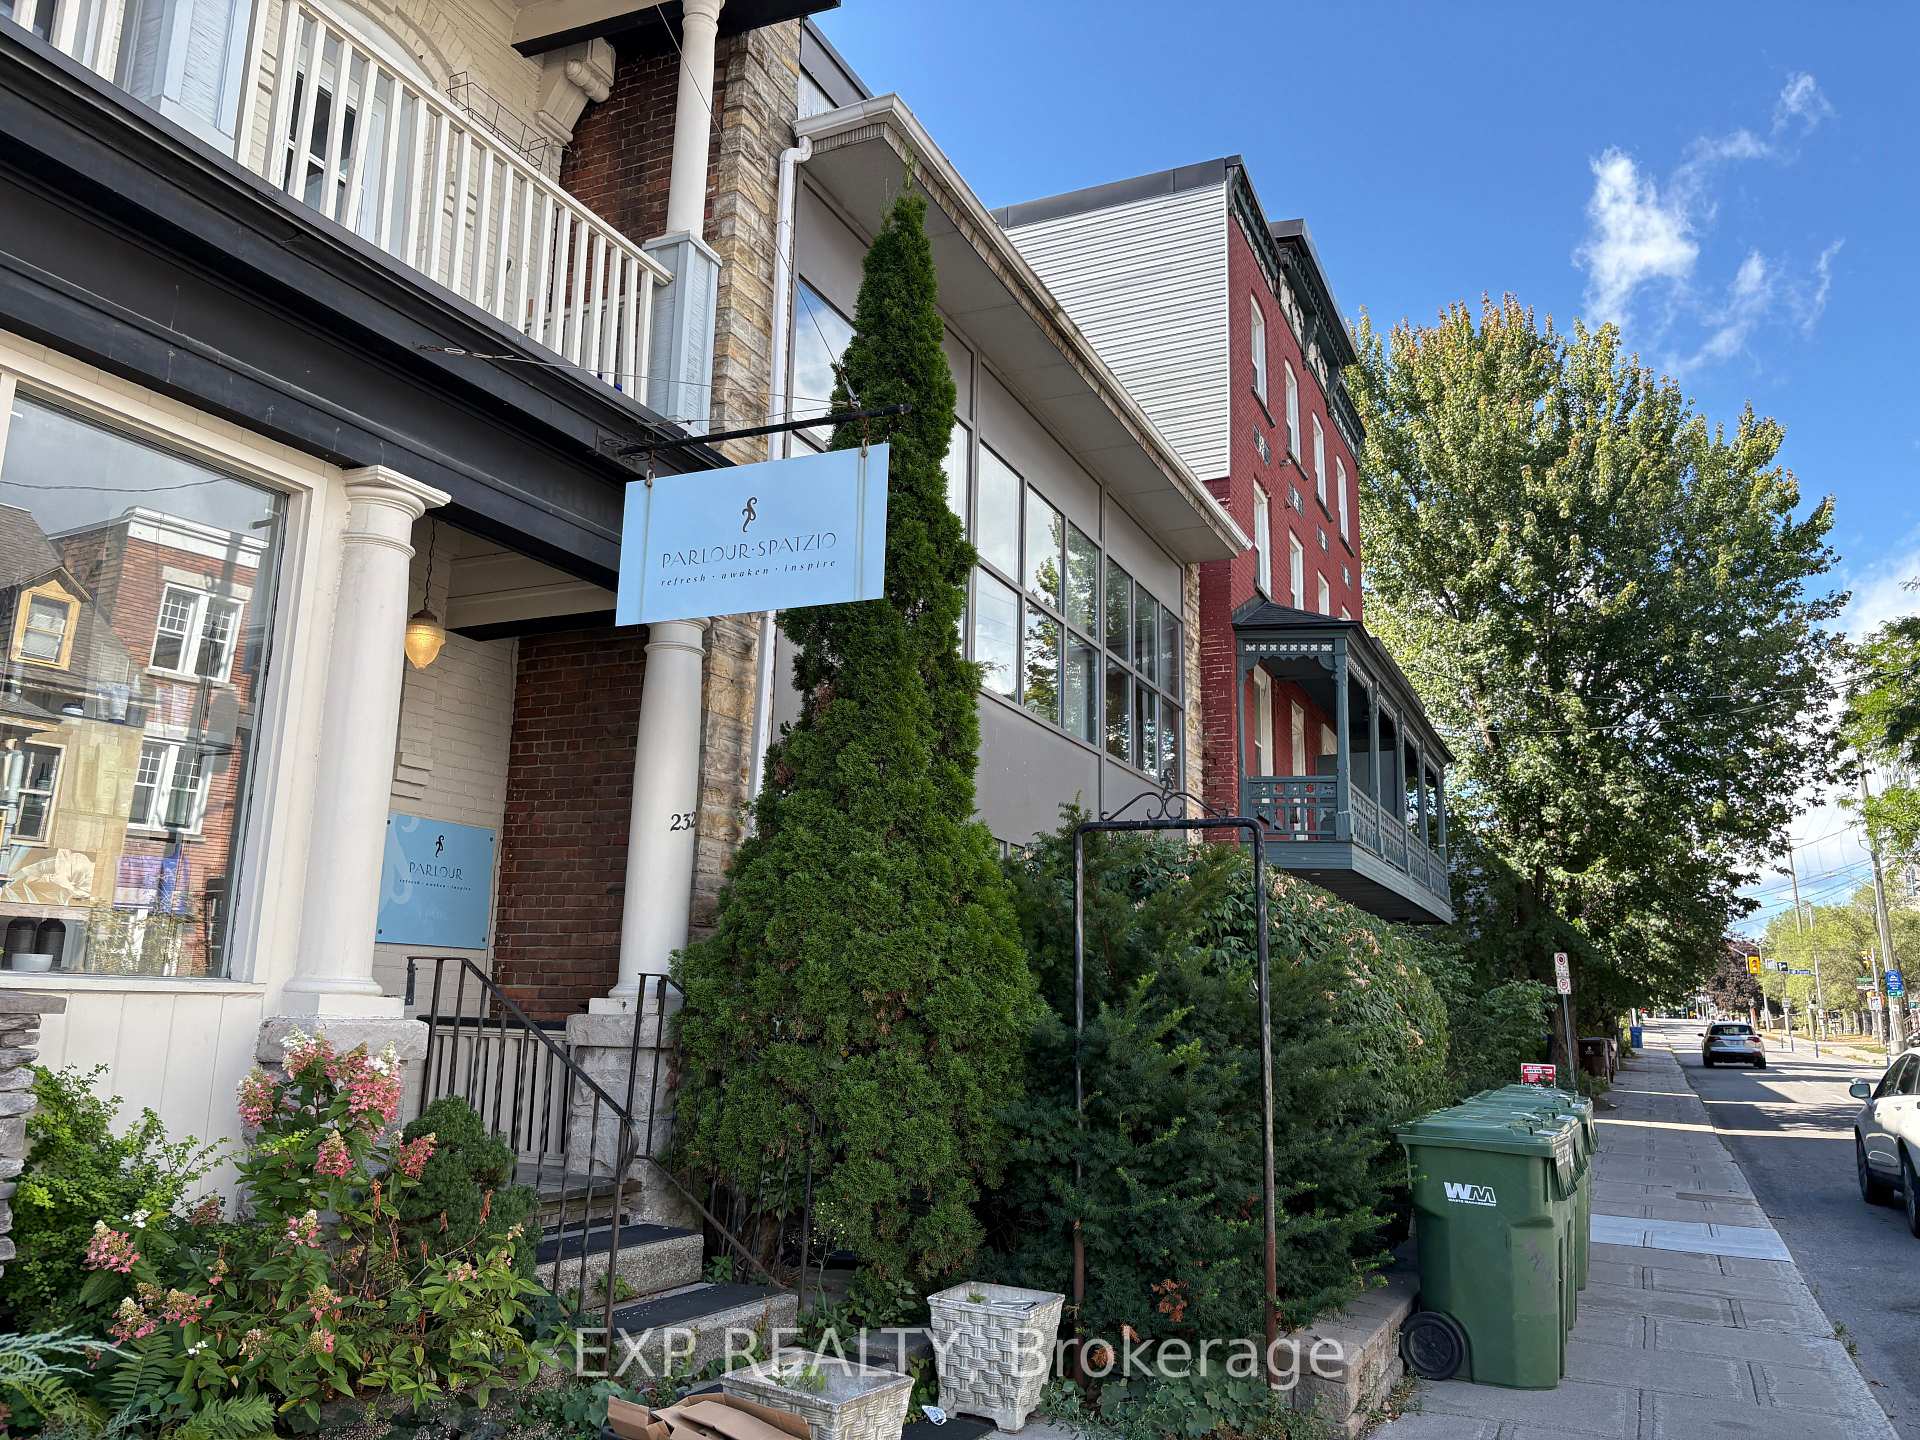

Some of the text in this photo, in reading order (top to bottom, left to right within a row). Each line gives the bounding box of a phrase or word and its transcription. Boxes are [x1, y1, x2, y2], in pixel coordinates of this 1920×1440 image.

[661, 559, 836, 587] refresh awaken inspire
[1444, 1181, 1497, 1204] WM
